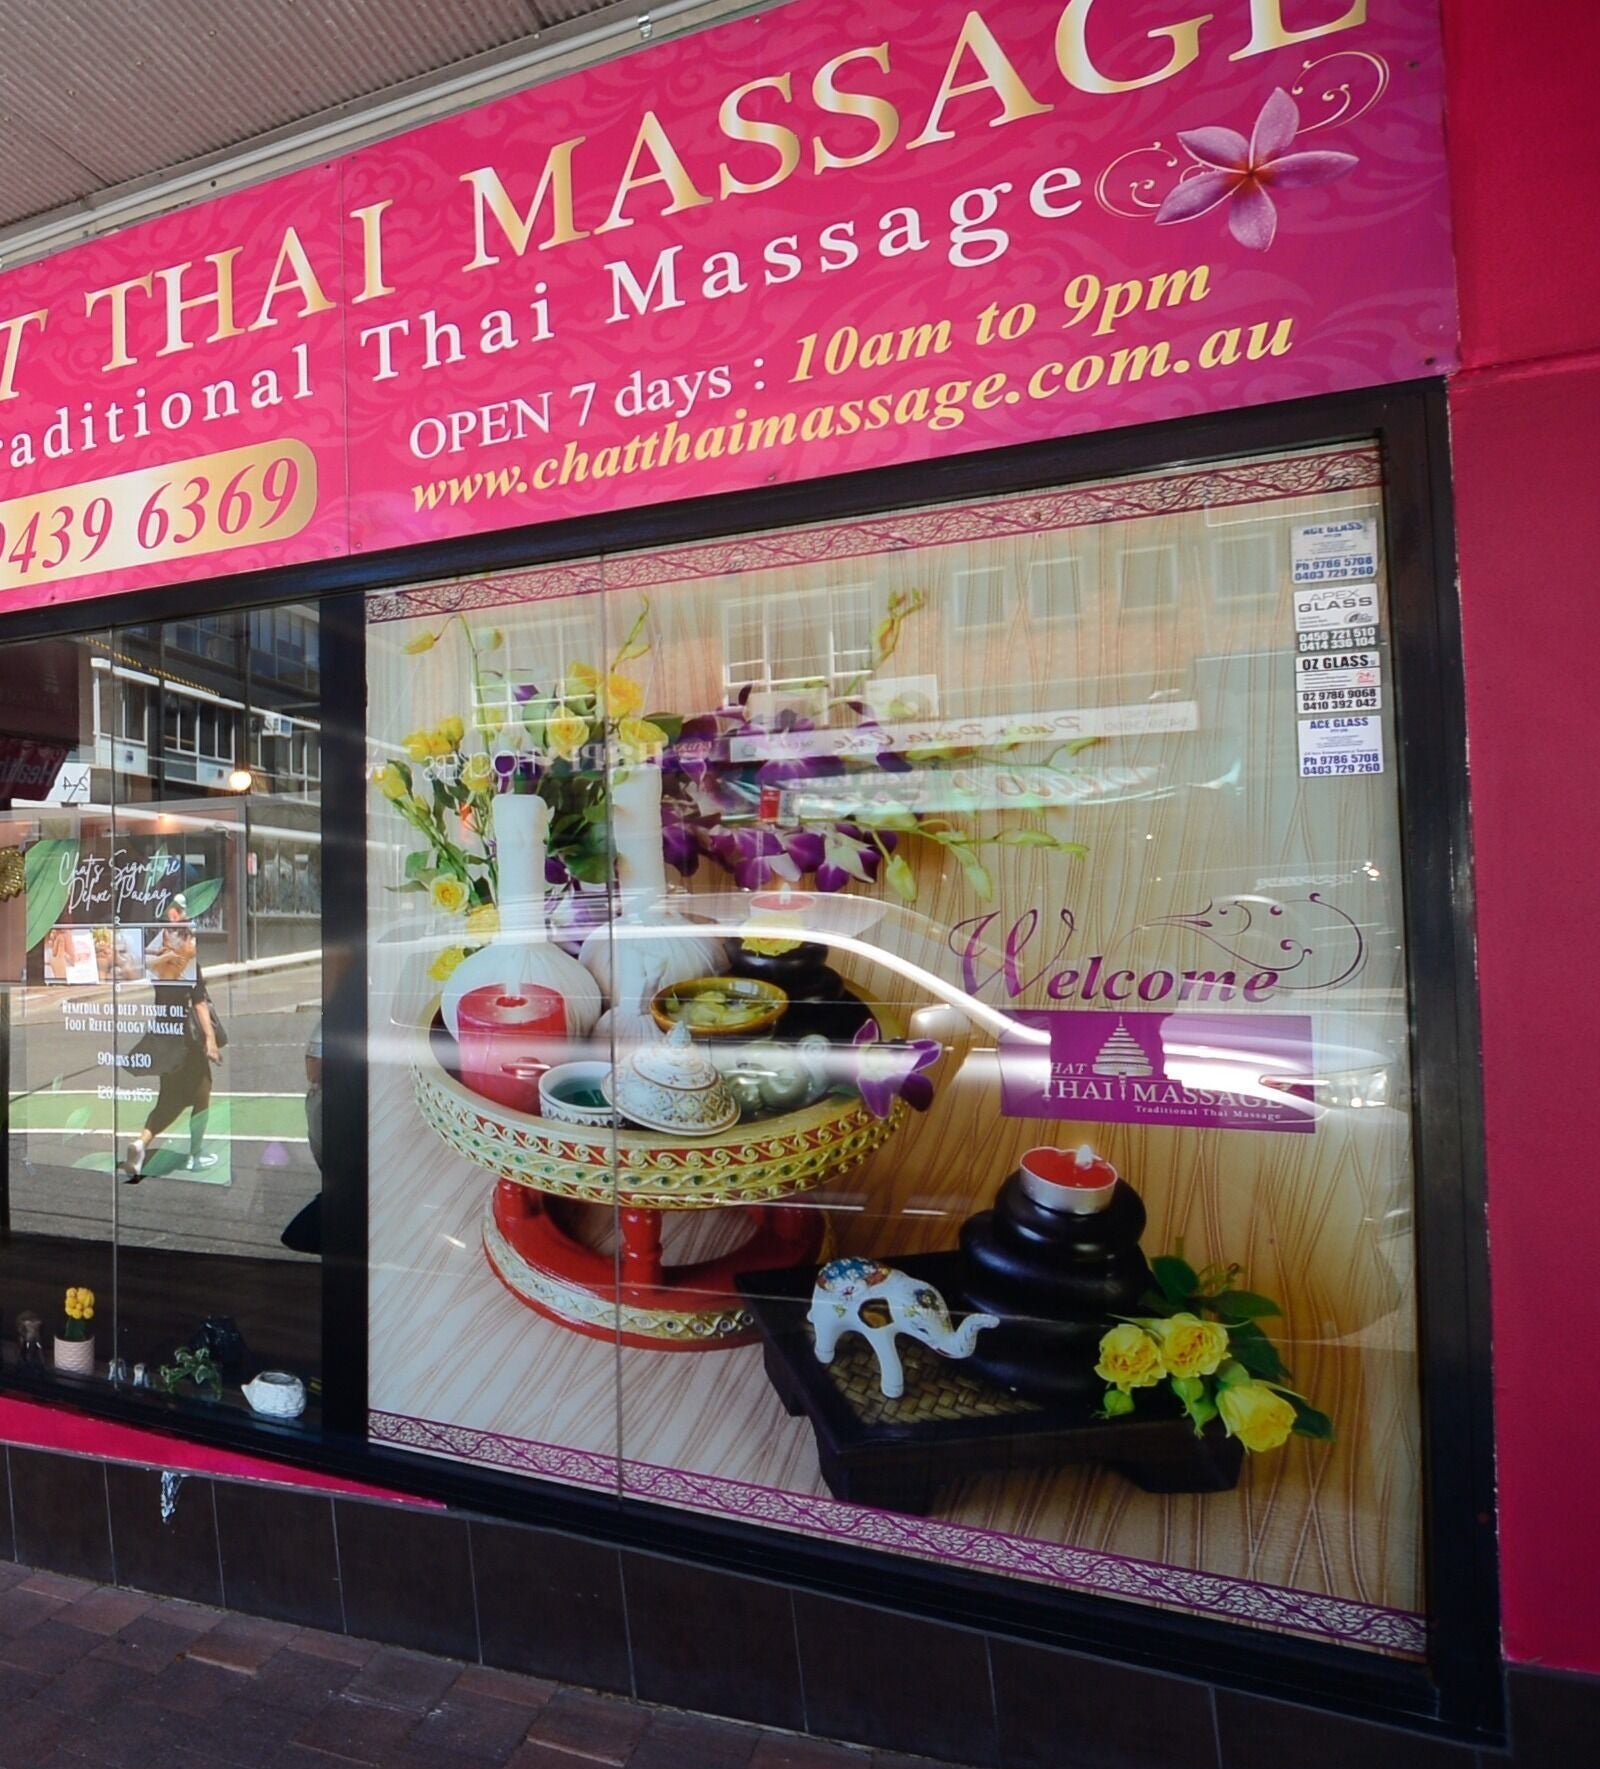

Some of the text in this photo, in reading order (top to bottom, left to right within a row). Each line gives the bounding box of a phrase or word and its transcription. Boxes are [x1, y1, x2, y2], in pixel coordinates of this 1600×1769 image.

[359, 282, 555, 382] Thai
[603, 165, 1083, 325] Massage
[85, 199, 395, 372] THAI
[408, 390, 554, 462] OPEN
[571, 381, 595, 429] 7
[614, 361, 733, 425] days
[787, 316, 952, 384] 10am
[976, 299, 1037, 346] to
[1063, 263, 1211, 337] 9pm
[411, 316, 1294, 513] www.chatthaimassage.com.au
[137, 457, 300, 550] 6369
[1327, 521, 1362, 533] GLASS
[1344, 556, 1372, 567] 5708
[1328, 568, 1347, 578] 729
[1351, 565, 1374, 576] 260
[1310, 588, 1359, 601] APEX
[1298, 596, 1373, 613] GLASS
[1353, 627, 1376, 638] 510
[1299, 640, 1329, 652] 0414
[1355, 636, 1376, 647] 104
[1302, 654, 1369, 671] OZ GLASS
[1303, 692, 1316, 701] 02
[1303, 698, 1377, 711] 0410 392 042
[1310, 717, 1369, 730] ACE GLASS
[1303, 753, 1379, 766] Ph 9786 5708
[1303, 763, 1380, 775] 0403 729 260
[948, 908, 1280, 1003] Welcome
[89, 1018, 145, 1035] REFLEOLOGY
[1051, 1062, 1087, 1075] HAT
[1041, 1079, 1115, 1101] THAI
[1135, 1105, 1281, 1122] Traditional Thai Massage
